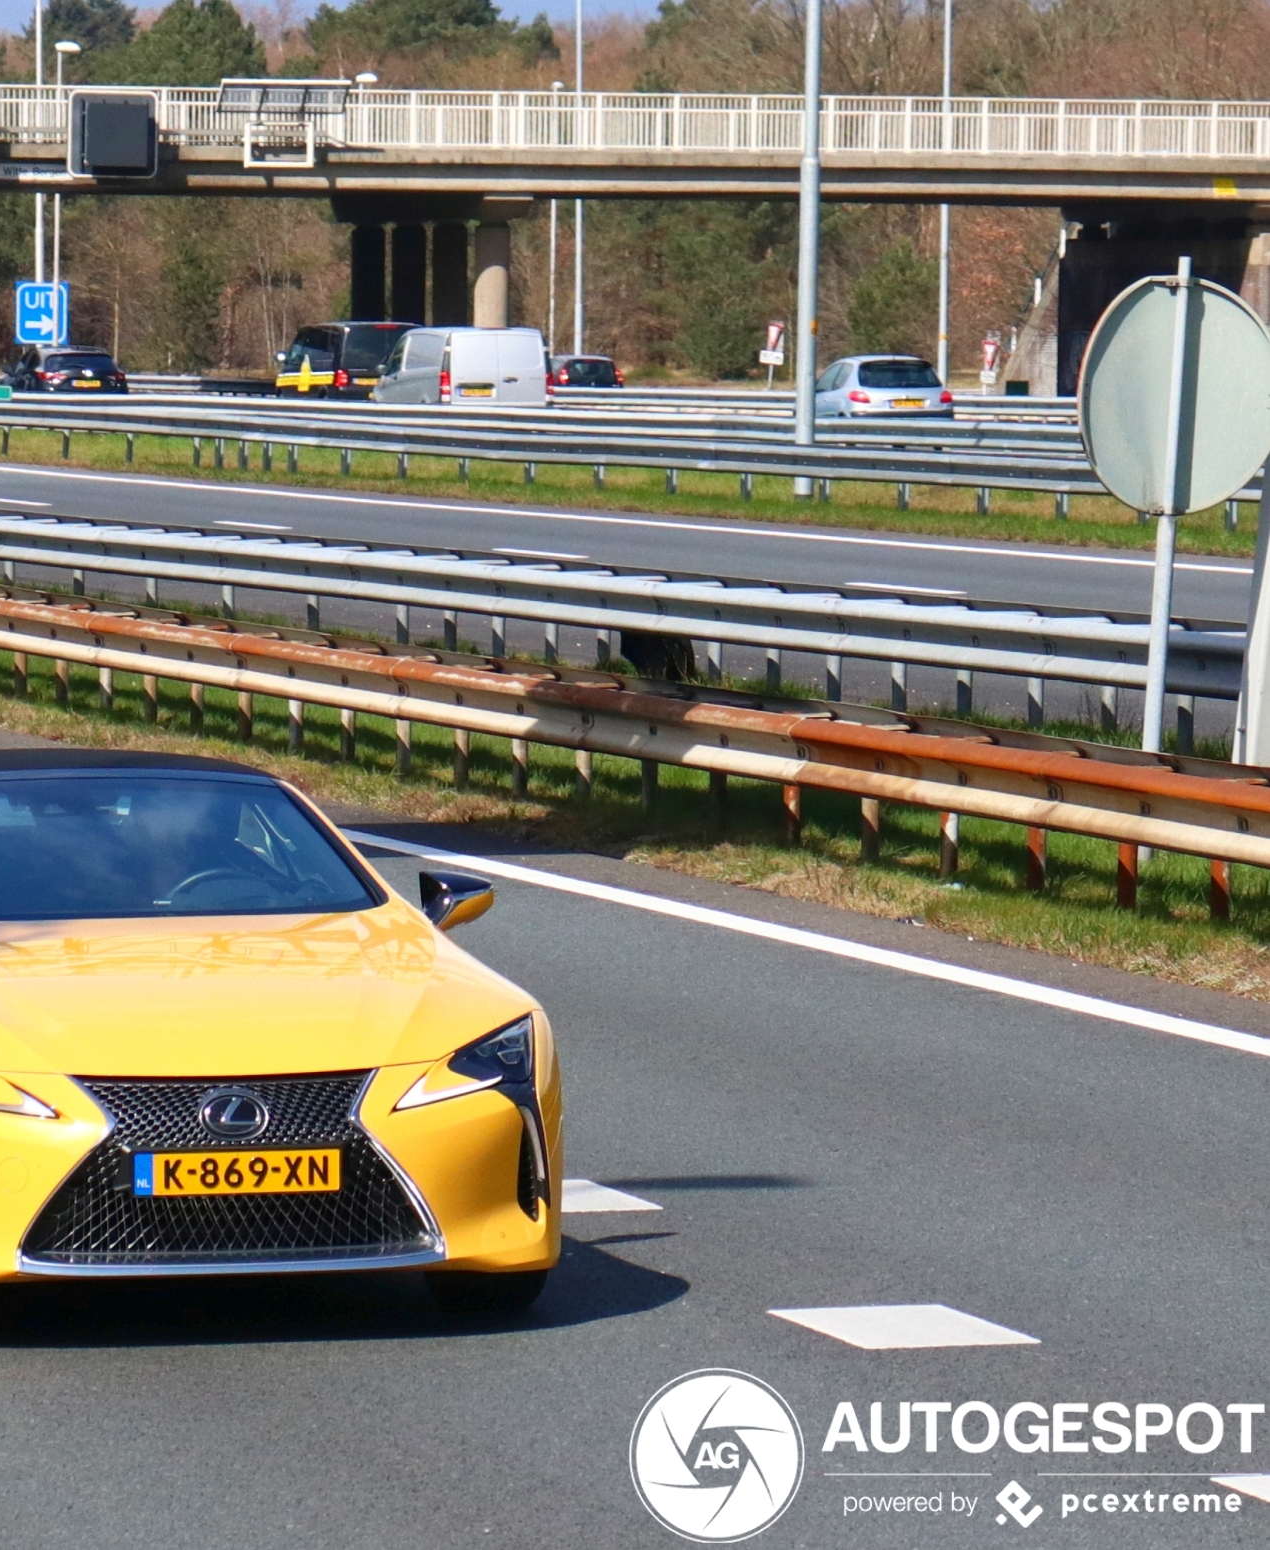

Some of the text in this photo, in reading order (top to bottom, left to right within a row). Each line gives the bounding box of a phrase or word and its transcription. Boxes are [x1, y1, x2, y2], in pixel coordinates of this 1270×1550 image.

[24, 291, 55, 309] UIT
[163, 1156, 330, 1190] K-869-XN
[137, 1178, 150, 1187] NL
